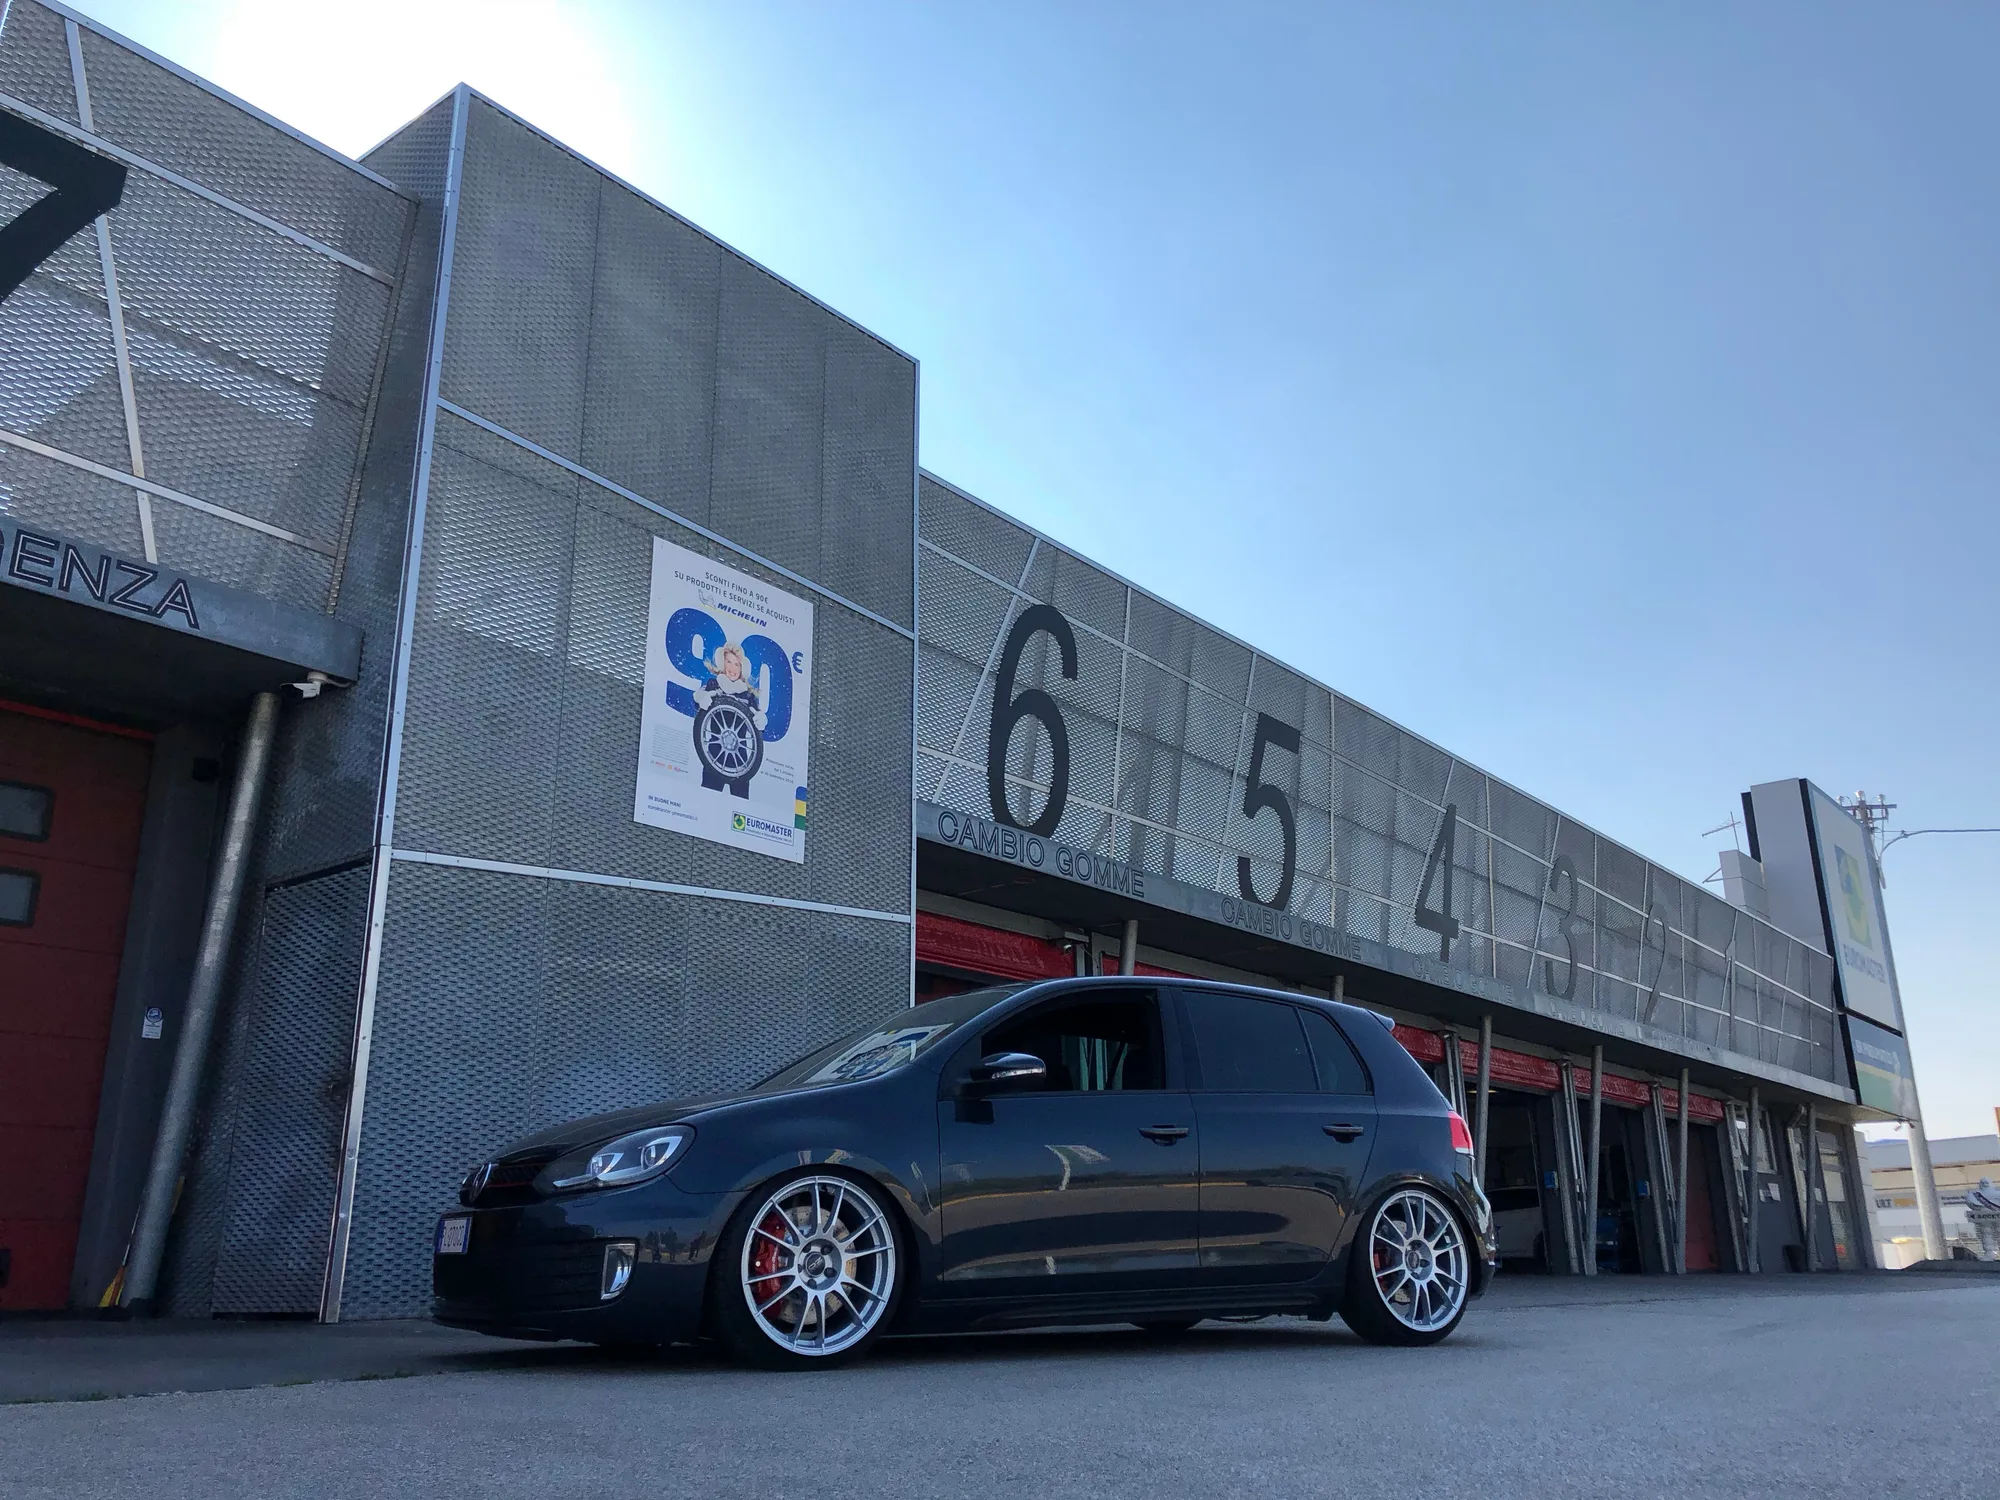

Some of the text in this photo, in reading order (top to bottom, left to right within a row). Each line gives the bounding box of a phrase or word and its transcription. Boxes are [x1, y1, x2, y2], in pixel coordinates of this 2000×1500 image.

[0, 527, 201, 630] ENZA
[674, 570, 684, 580] SU
[686, 575, 721, 595] PRODOTTI
[729, 592, 755, 609] SERVIZI
[756, 604, 765, 613] SE
[766, 608, 795, 626] ACQUISTI
[705, 571, 730, 588] SCONTI
[731, 582, 748, 595] FINO
[717, 602, 768, 628] MICHELIN
[987, 604, 1078, 839] 6
[746, 817, 793, 838] EUROMASTER
[938, 810, 1145, 899] CAMBIO GOMME
[1237, 712, 1300, 910] 5
[1415, 803, 1460, 963] 4
[1546, 854, 1578, 1001] 3
[1221, 897, 1362, 961] CAMBIO GOMME
